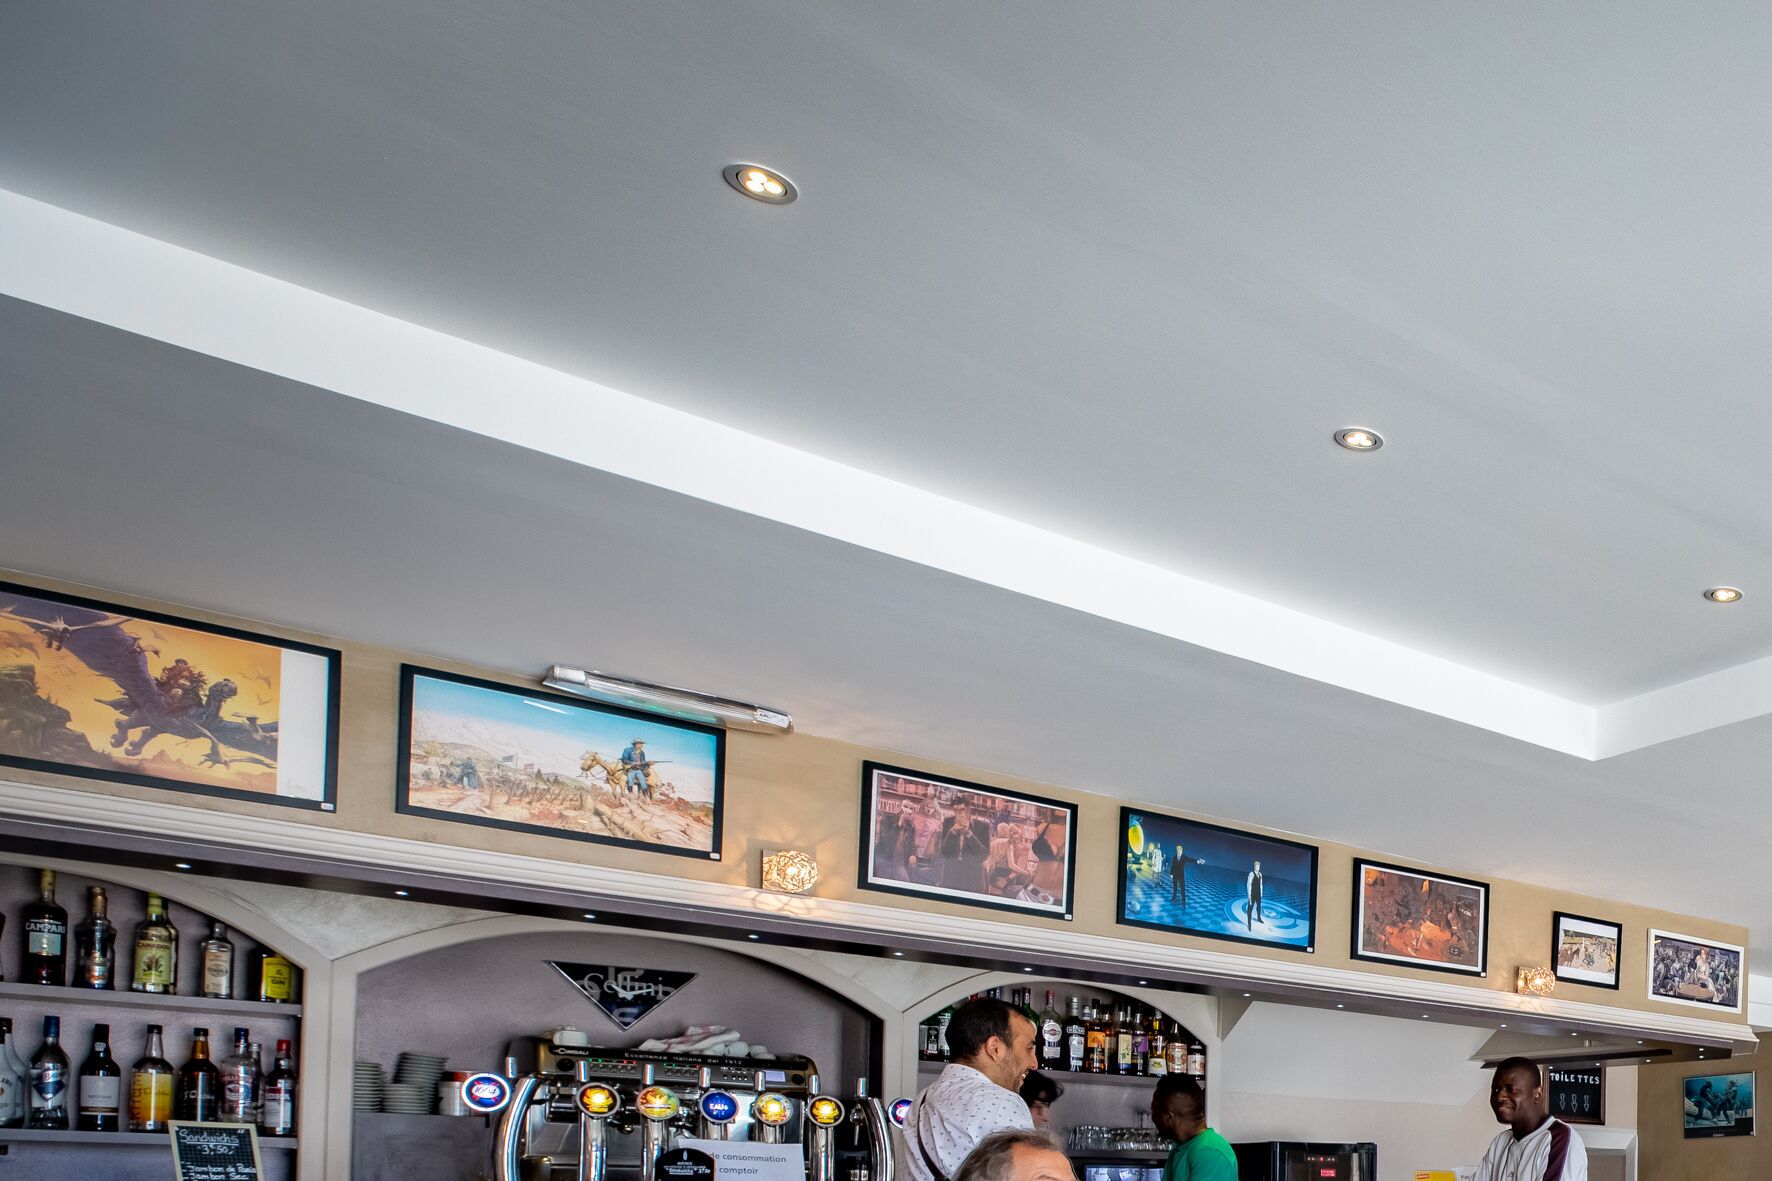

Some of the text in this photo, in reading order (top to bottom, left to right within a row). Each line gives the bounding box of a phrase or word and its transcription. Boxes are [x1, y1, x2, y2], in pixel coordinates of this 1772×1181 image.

[25, 922, 66, 934] CAMPARI
[722, 1153, 787, 1163] consommation
[719, 1167, 759, 1175] comptoir
